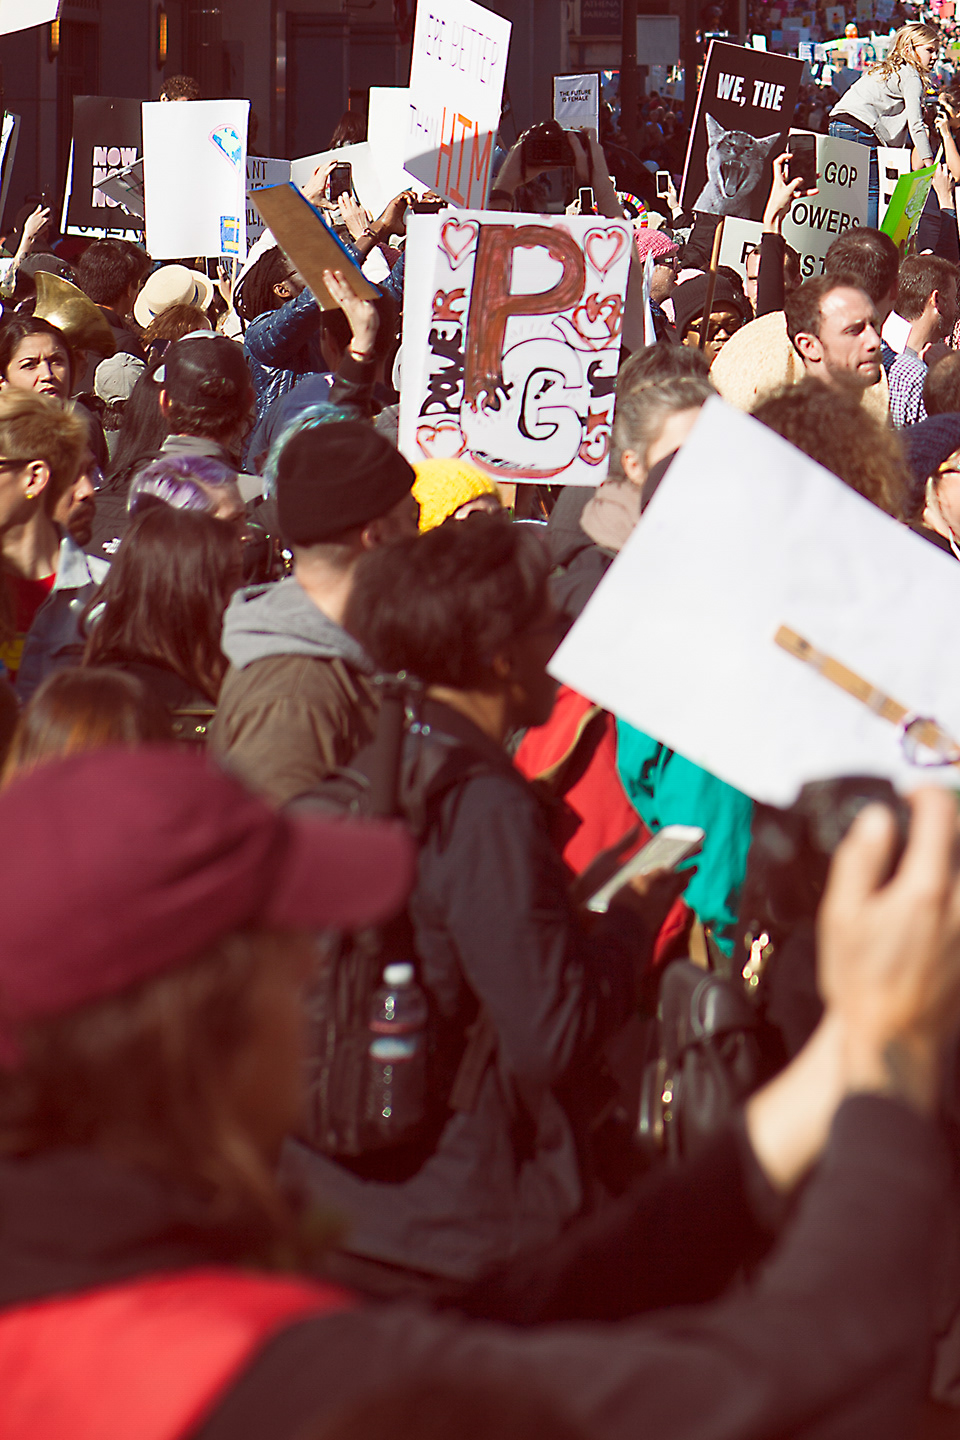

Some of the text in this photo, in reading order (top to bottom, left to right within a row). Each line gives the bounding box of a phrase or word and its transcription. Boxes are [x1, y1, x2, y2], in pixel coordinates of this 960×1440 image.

[583, 0, 619, 8] ATHENA
[583, 10, 619, 19] PARKING
[716, 72, 786, 112] WE, THE
[92, 146, 137, 167] NOW
[435, 107, 493, 210] HIM
[824, 161, 858, 188] GOP
[792, 203, 861, 235] OWERS
